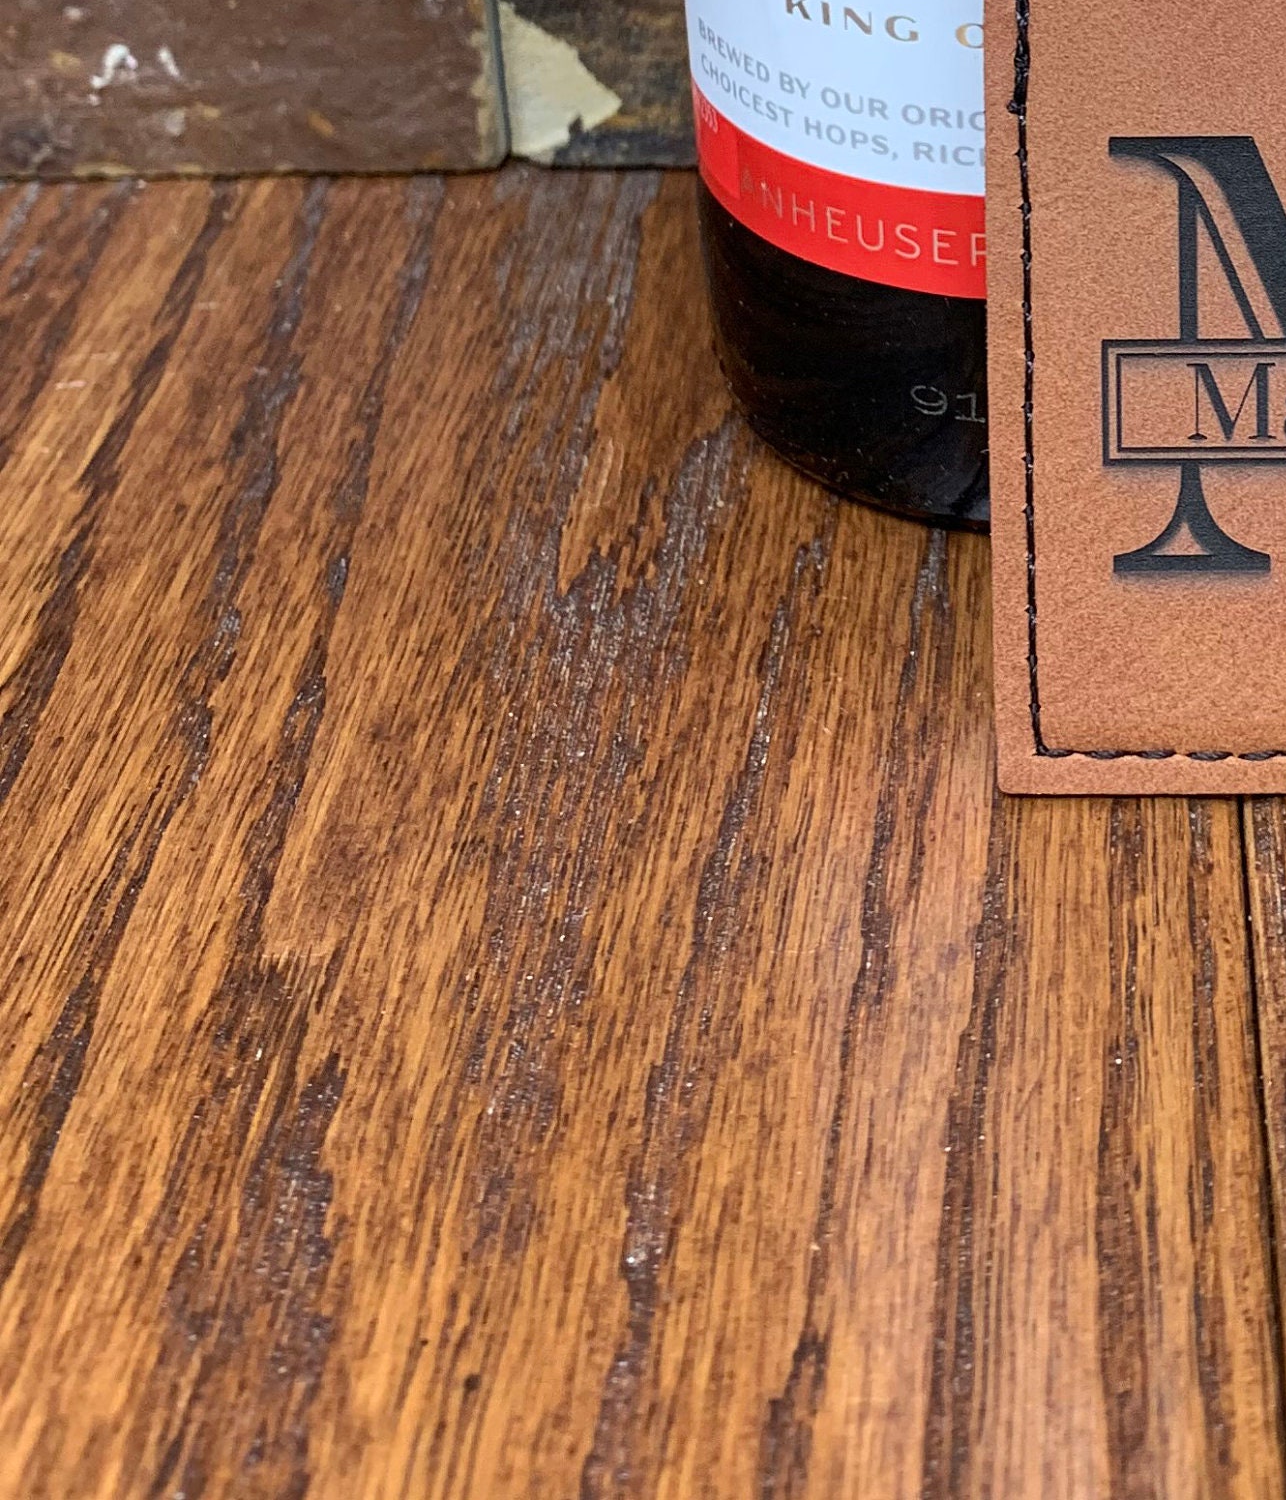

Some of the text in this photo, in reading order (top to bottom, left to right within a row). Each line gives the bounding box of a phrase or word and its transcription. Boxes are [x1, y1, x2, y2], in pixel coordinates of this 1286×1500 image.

[698, 17, 770, 84] BREWED
[779, 71, 812, 100] BY
[820, 87, 890, 120] OUR
[699, 54, 795, 126] CHOICEST
[804, 116, 899, 161] HOPS,
